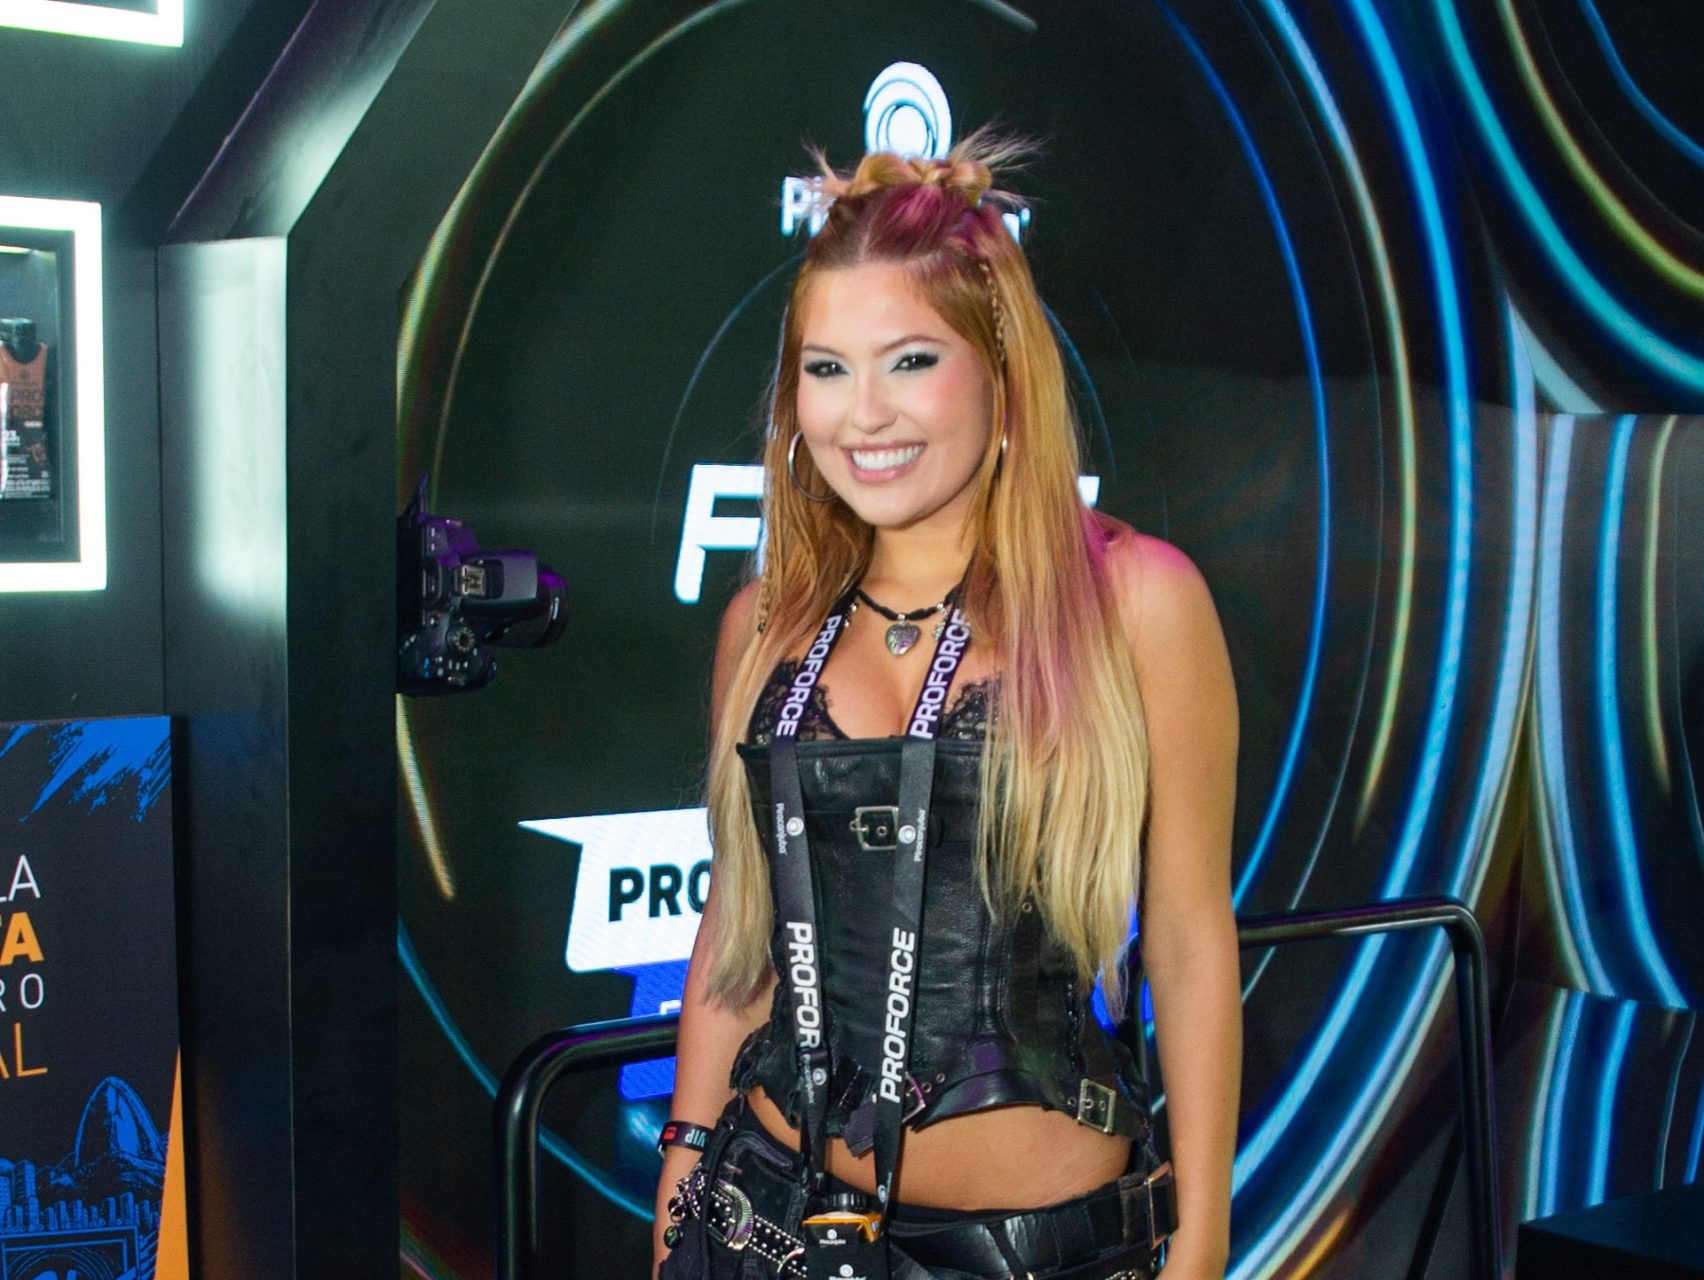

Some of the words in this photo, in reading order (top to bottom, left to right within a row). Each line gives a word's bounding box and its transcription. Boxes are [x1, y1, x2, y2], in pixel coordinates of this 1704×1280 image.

[776, 614, 842, 737] PROFORCE
[909, 608, 970, 740] PROFORCE
[0, 854, 41, 901] A
[0, 911, 45, 966] A
[880, 927, 916, 1104] PROFORCE
